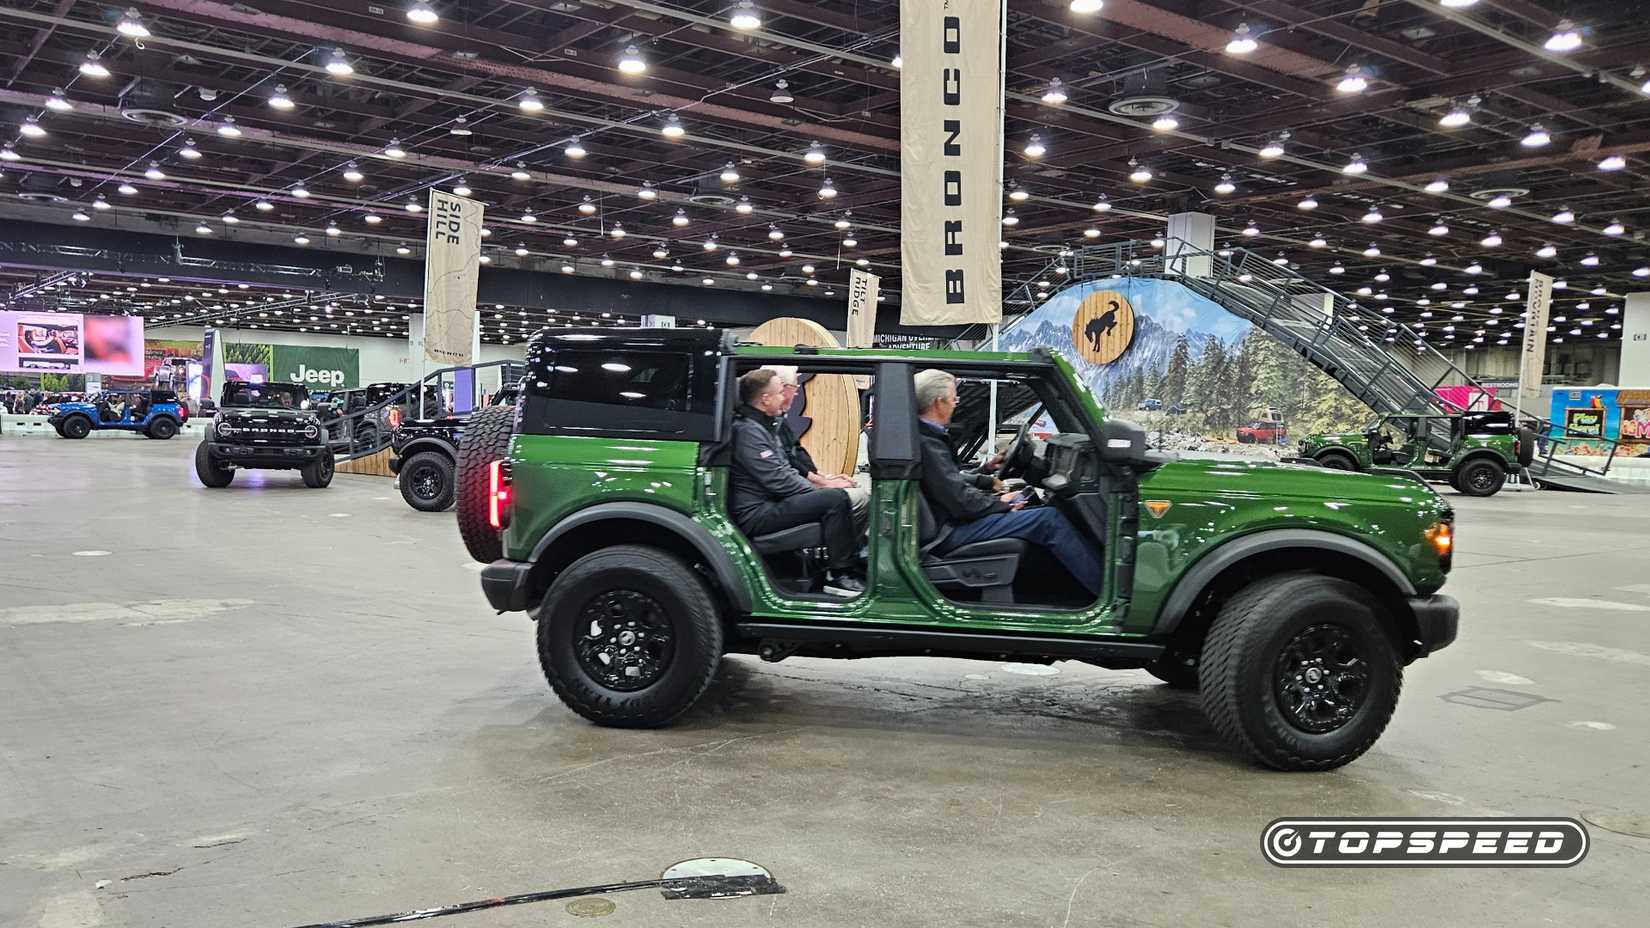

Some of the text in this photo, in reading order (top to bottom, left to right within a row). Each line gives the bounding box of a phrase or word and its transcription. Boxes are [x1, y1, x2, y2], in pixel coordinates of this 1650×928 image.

[944, 16, 964, 304] BRONCO
[436, 199, 448, 240] HILL
[447, 202, 461, 245] SIDE
[852, 276, 862, 316] RIDGE
[290, 364, 345, 387] Jeep
